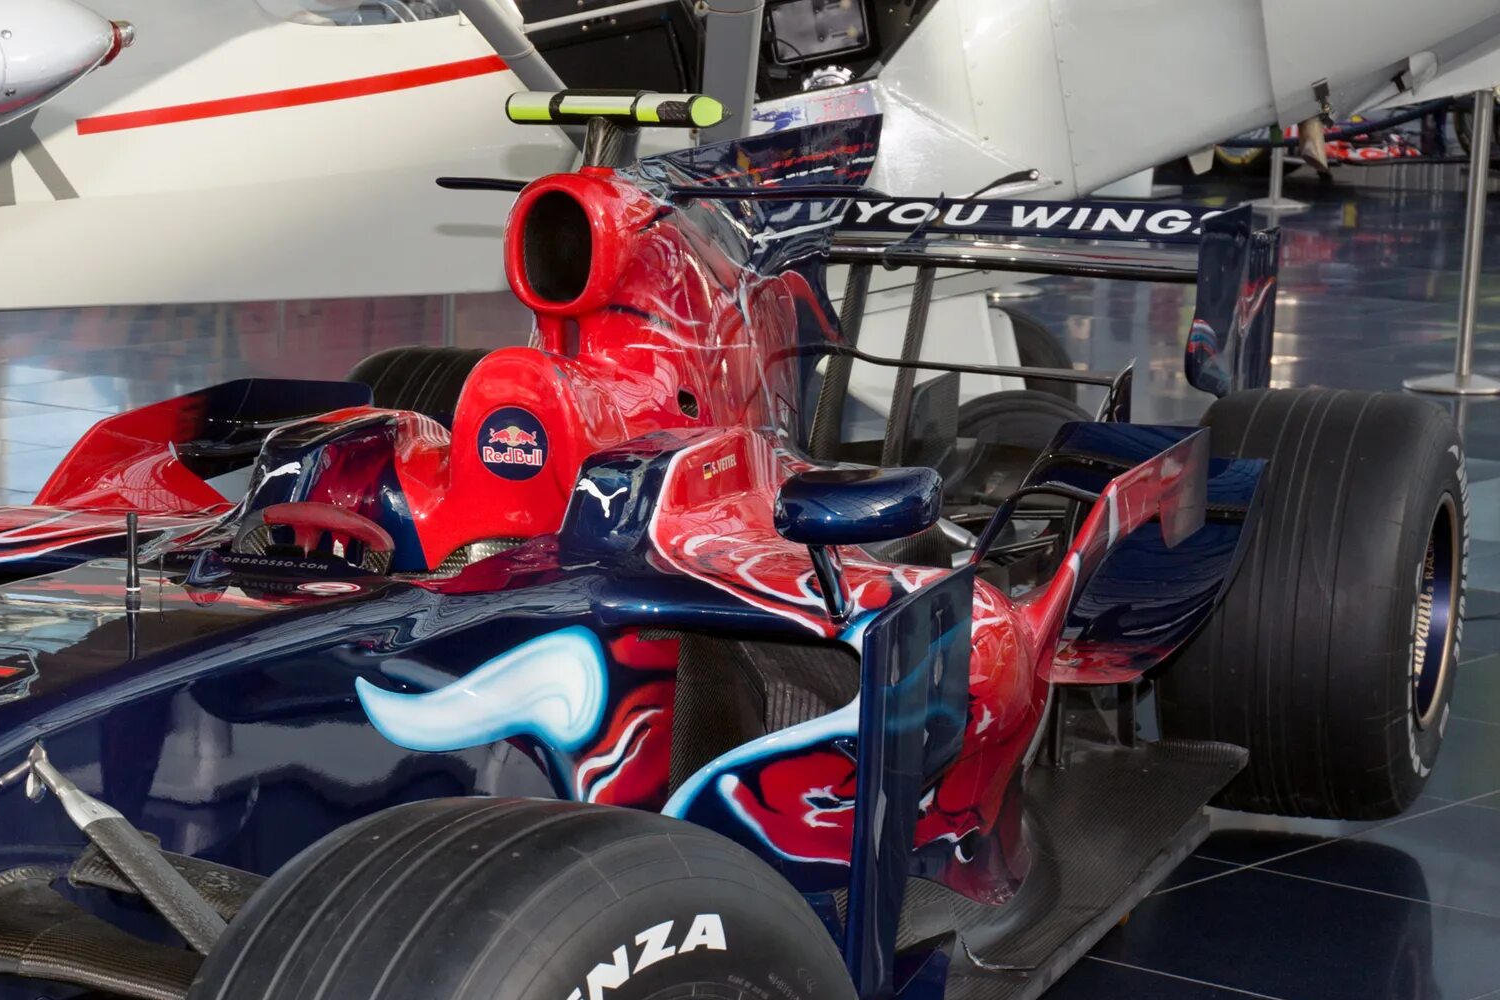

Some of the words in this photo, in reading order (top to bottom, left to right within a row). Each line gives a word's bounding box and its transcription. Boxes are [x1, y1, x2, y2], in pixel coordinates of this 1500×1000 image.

[855, 201, 990, 226] YOU
[483, 446, 513, 463] Red
[514, 448, 542, 466] Bull
[176, 553, 329, 571] WWOROROSSO.COM
